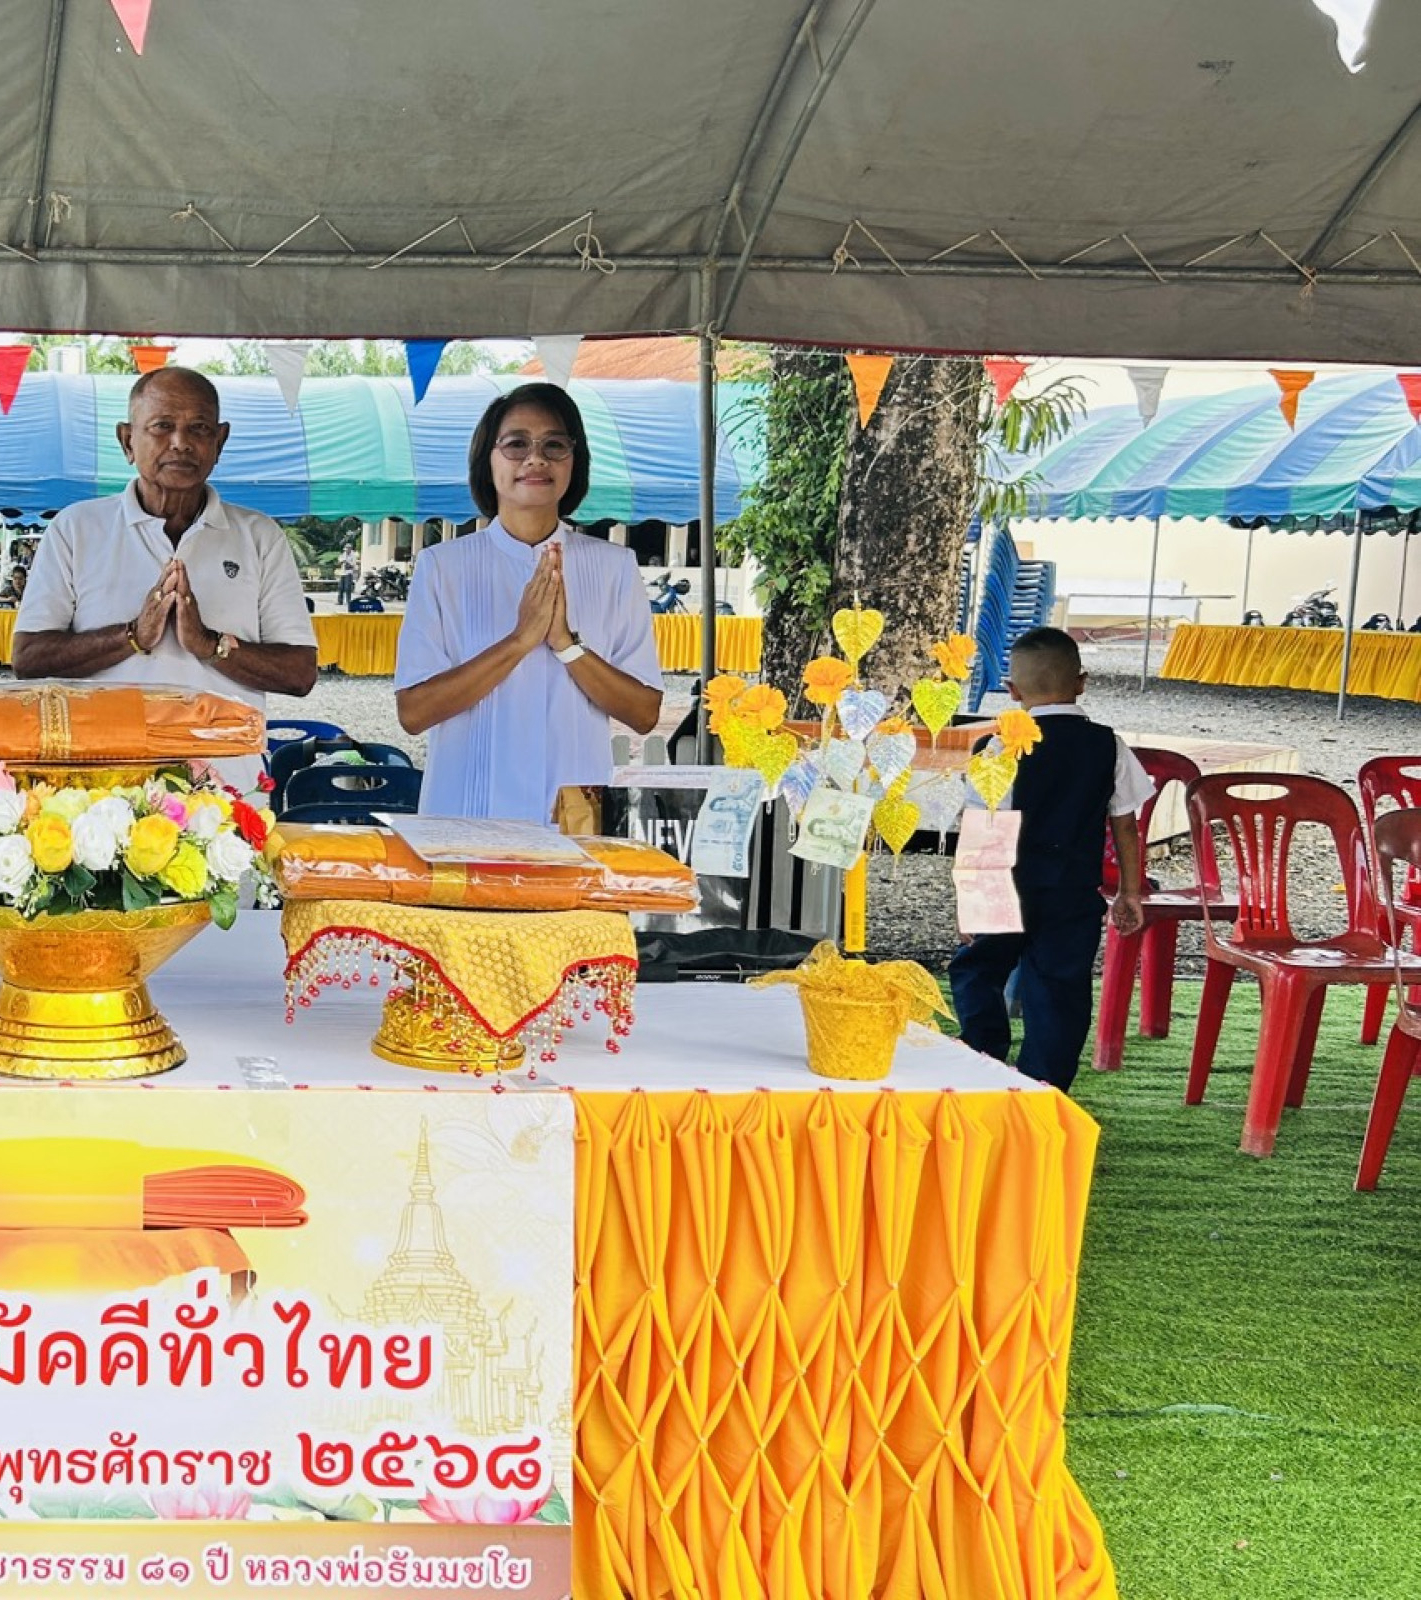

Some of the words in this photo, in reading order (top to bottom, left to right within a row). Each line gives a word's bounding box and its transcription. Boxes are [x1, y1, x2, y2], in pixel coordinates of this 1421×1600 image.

[297, 1430, 542, 1491] ๒๕๖๘
[140, 1557, 190, 1583] ๘๑
[205, 1546, 230, 1581] ปี
[244, 1548, 529, 1585] หลวงพ่อธัมมชโย
